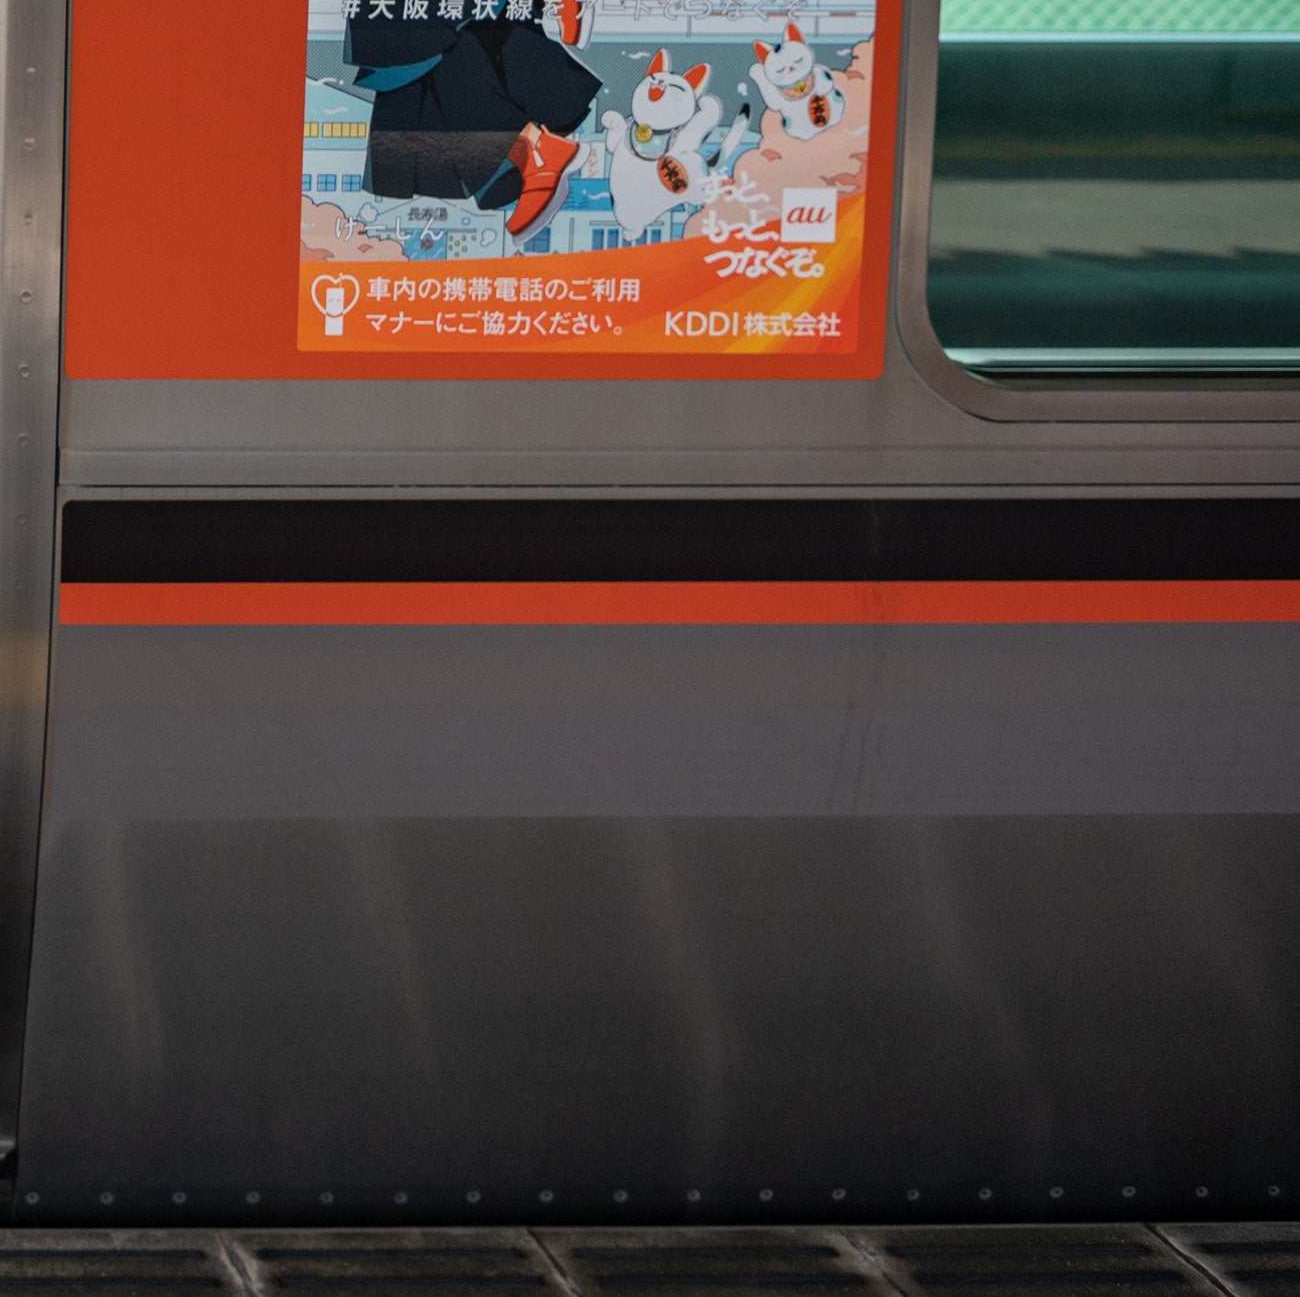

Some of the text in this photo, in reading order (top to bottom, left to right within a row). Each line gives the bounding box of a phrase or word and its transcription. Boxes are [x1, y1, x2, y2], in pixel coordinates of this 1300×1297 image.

[786, 206, 832, 224] au
[703, 247, 825, 278] つなぐぞ。
[366, 276, 641, 303] 車内の携帯電話のご利用
[365, 310, 624, 336] マナーにご協力ください。
